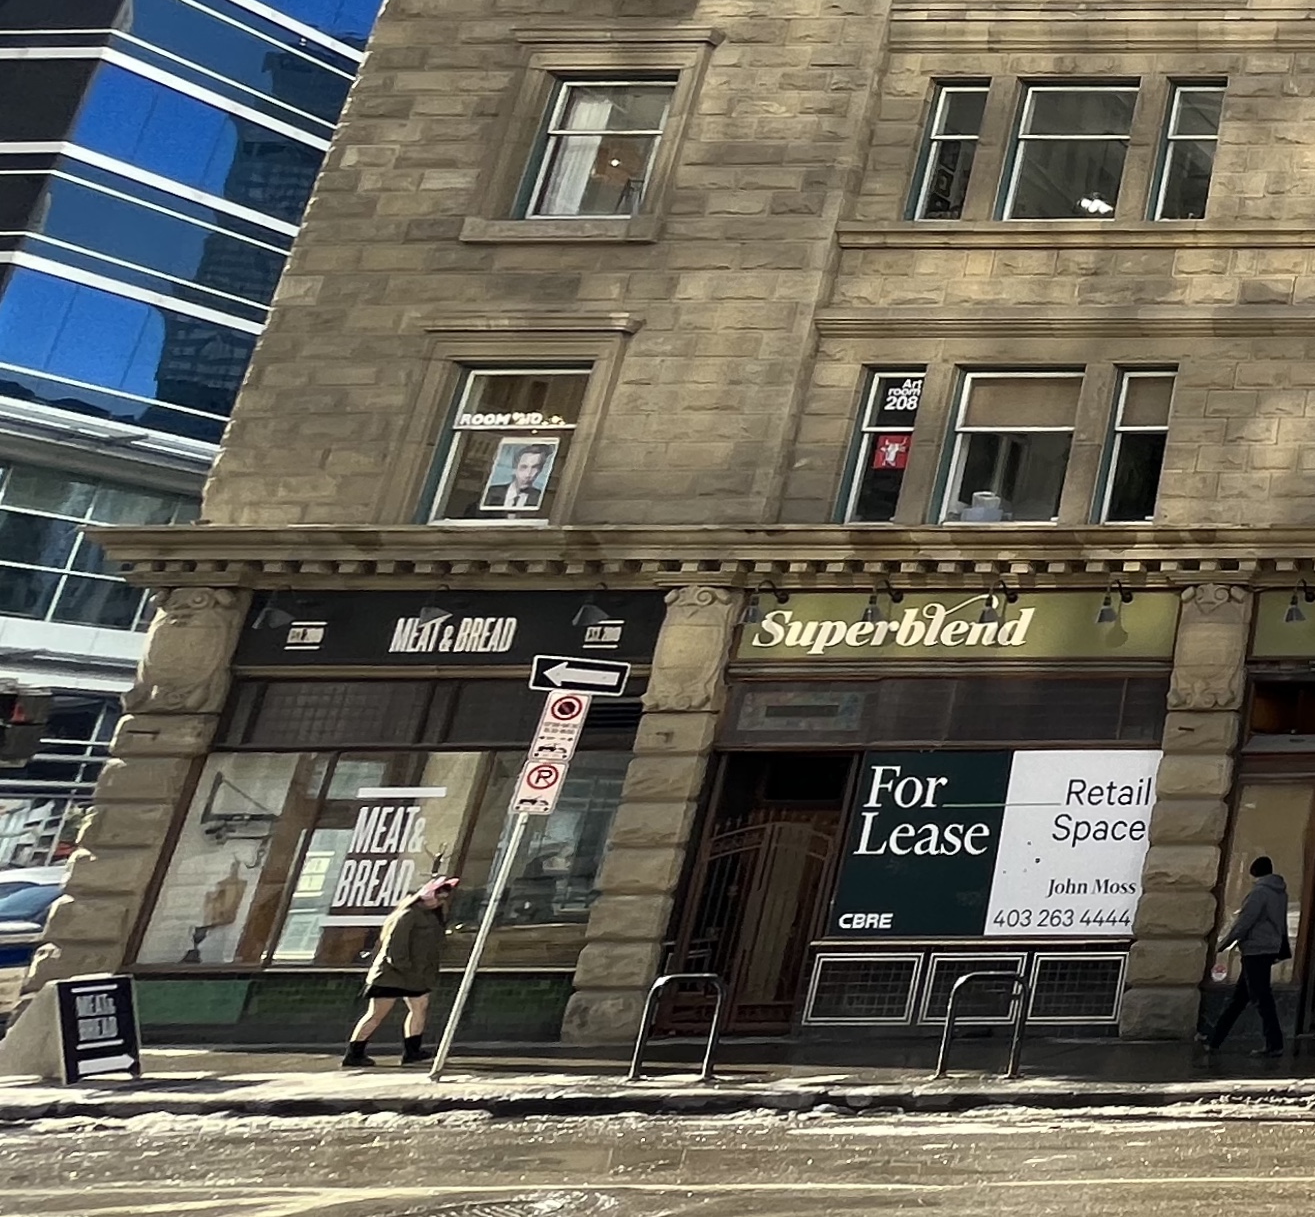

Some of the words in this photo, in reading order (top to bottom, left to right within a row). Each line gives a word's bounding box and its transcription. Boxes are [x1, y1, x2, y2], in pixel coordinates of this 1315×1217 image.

[888, 388, 920, 396] room
[902, 379, 922, 389] Art
[884, 396, 918, 410] 208
[459, 413, 511, 425] ROOM
[439, 625, 454, 652] &
[453, 617, 518, 652] BREAD
[752, 594, 1036, 655] Superblend
[863, 765, 948, 808] For
[1065, 778, 1152, 806] Retail
[853, 811, 990, 856] Lease
[1052, 813, 1146, 848] Space
[332, 859, 416, 907] BREAD
[1045, 878, 1088, 898] John
[1090, 879, 1136, 895] Moss
[838, 912, 894, 930] CBRE
[993, 909, 1032, 927] 403
[1037, 909, 1074, 927] 263
[1079, 909, 1132, 927] 4444
